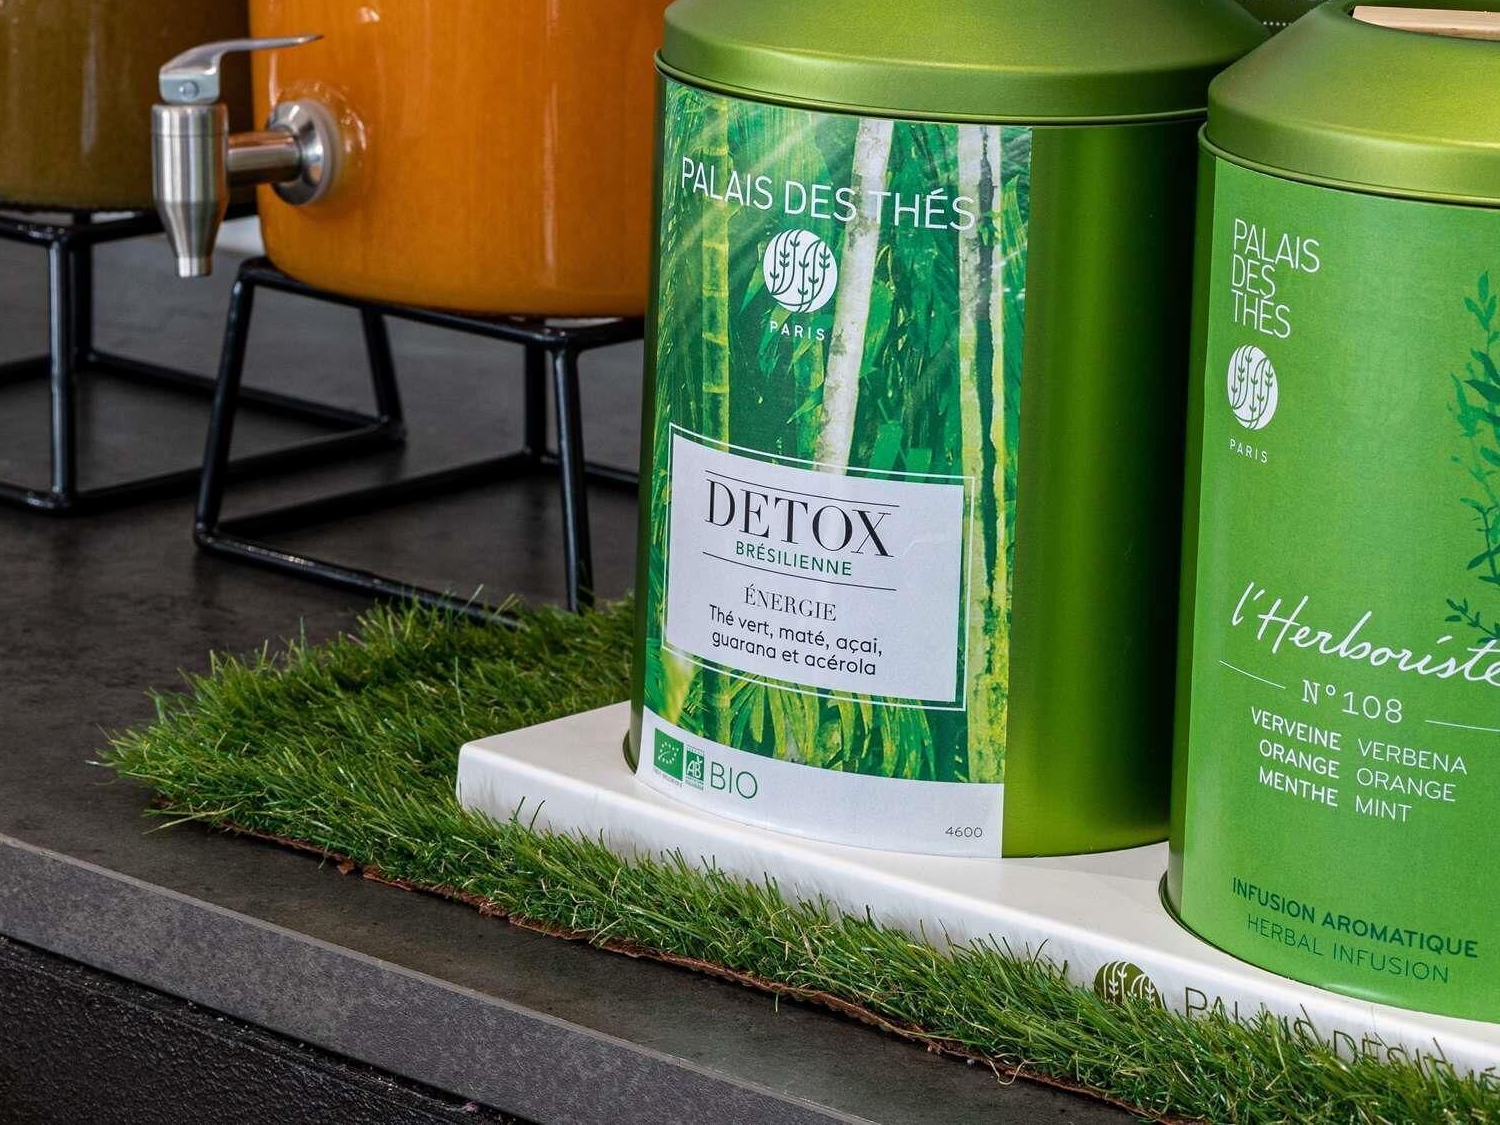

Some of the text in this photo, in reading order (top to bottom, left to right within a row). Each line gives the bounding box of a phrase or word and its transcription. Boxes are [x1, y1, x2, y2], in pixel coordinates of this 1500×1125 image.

[681, 156, 976, 231] PALAIS DES THÉS
[1233, 218, 1320, 273] PALAIS
[1231, 254, 1276, 299] DES
[769, 321, 826, 342] PARIS
[1231, 288, 1291, 339] THÉS
[1229, 438, 1268, 463] PARIS
[704, 478, 895, 558] DETOX
[735, 538, 852, 576] BRÉSILIENNE
[743, 583, 837, 622] ÉNERGIE
[709, 604, 883, 657] Thé vert, maté, açai,
[712, 630, 876, 676] guarana et acérola
[1251, 707, 1342, 751] VERVEINE
[1259, 739, 1340, 779] ORANGE
[1357, 738, 1468, 776] VERBENA
[710, 762, 758, 799] BIO
[1259, 766, 1339, 807] MENTHE
[1356, 768, 1457, 803] ORANGE
[1355, 795, 1412, 823] MINT
[945, 826, 984, 839] 4600
[1232, 877, 1479, 959] INFUSION AROMATIQUE
[1247, 914, 1450, 984] HERBAL INFUSION
